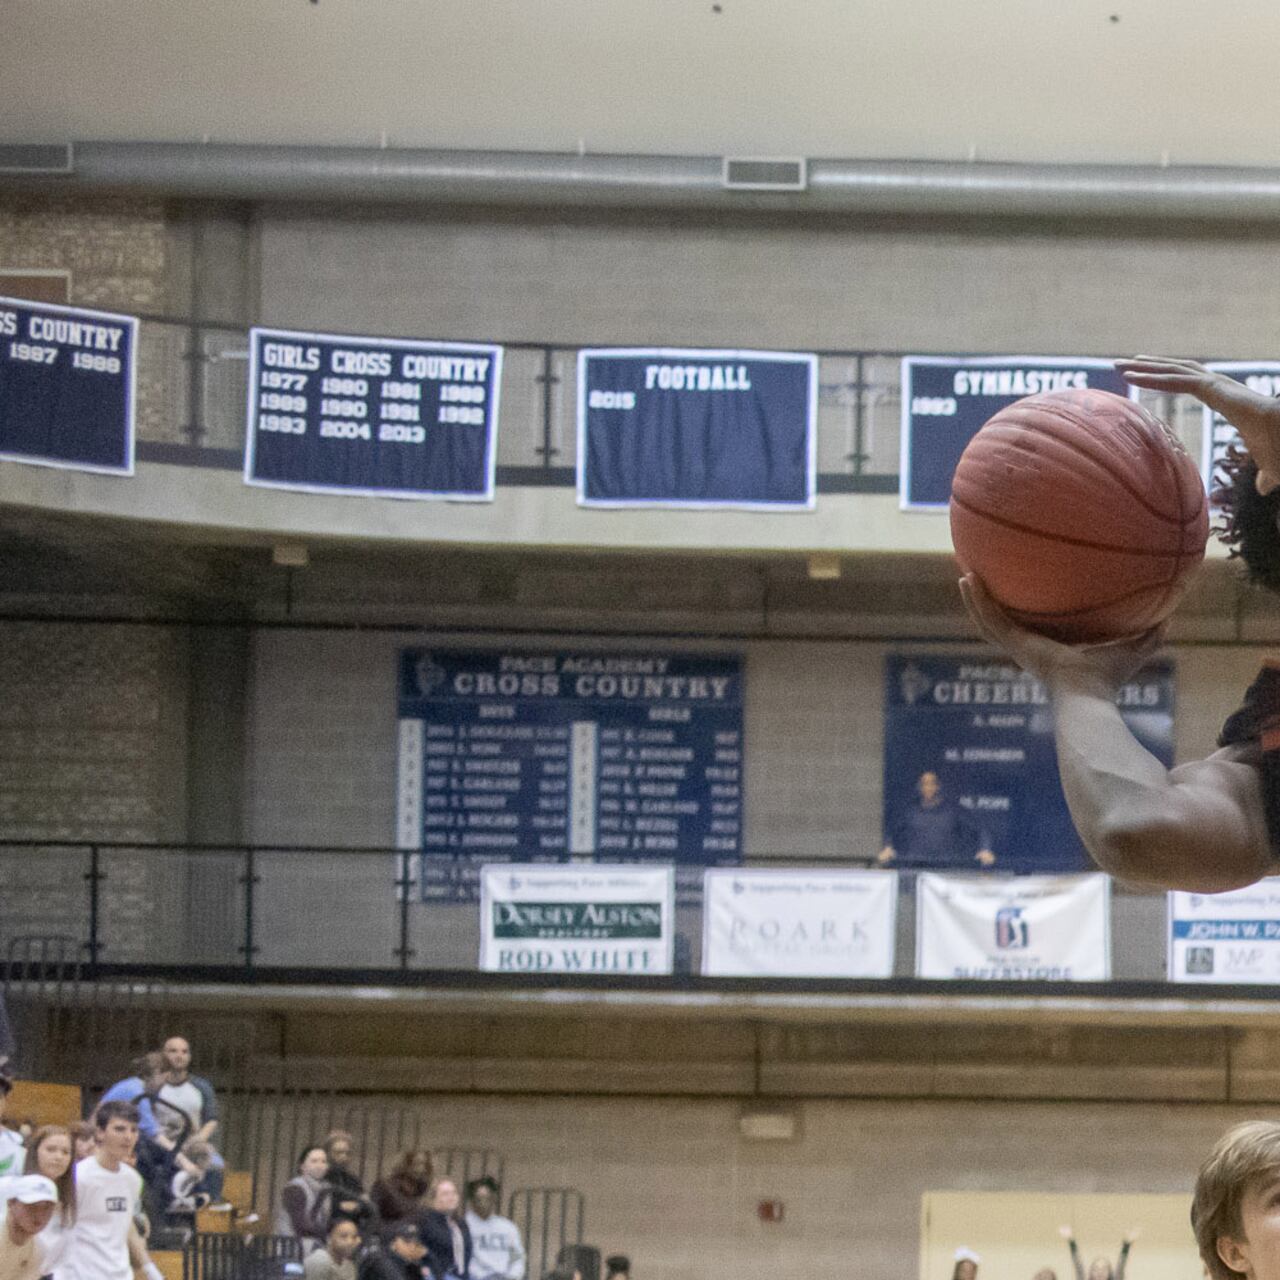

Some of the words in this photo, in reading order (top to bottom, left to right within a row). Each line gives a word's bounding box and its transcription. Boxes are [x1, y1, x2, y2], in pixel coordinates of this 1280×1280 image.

[30, 316, 124, 352] COUNTRY
[73, 351, 121, 374] 1988
[264, 343, 320, 370] GIRLS
[332, 351, 391, 375] CROSS
[403, 356, 489, 382] COUNTRY
[261, 371, 307, 391] 1977
[646, 365, 751, 390] FOOTBALL
[954, 370, 1089, 395] GYMNASTICS
[320, 420, 370, 439] 2004
[379, 424, 425, 443] 2013
[454, 673, 561, 696] CROSS
[576, 675, 730, 700] COUNTRY
[1187, 922, 1239, 939] JOHN
[499, 949, 554, 969] ROD
[562, 949, 649, 969] WHITE
